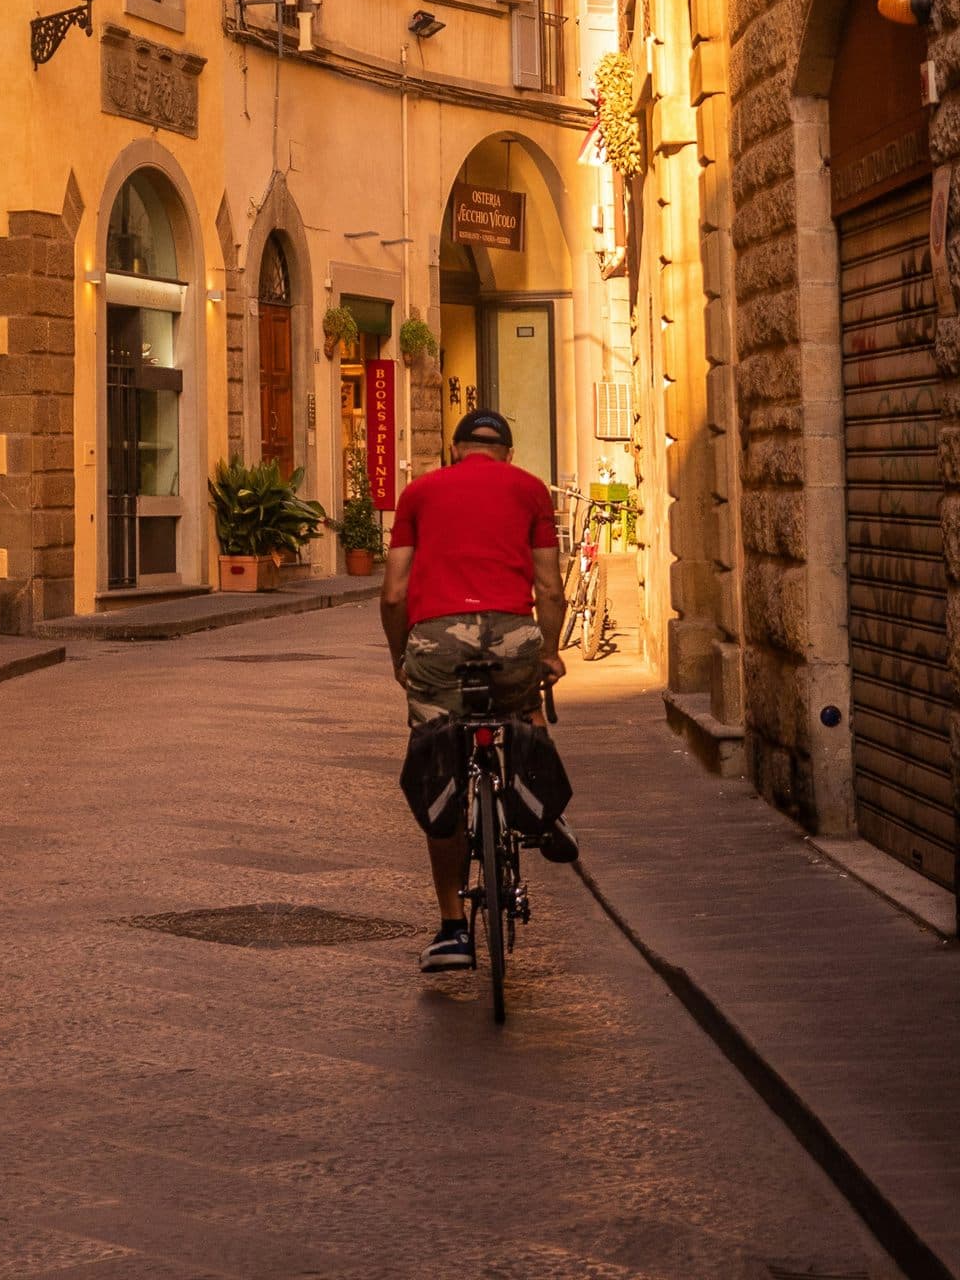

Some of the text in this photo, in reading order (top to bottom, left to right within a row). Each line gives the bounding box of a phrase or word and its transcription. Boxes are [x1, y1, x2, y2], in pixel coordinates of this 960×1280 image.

[472, 190, 501, 207] OSTERIA
[457, 203, 516, 229] VECCHIO VICOLO
[375, 368, 387, 498] BOOKS & PRINTS
